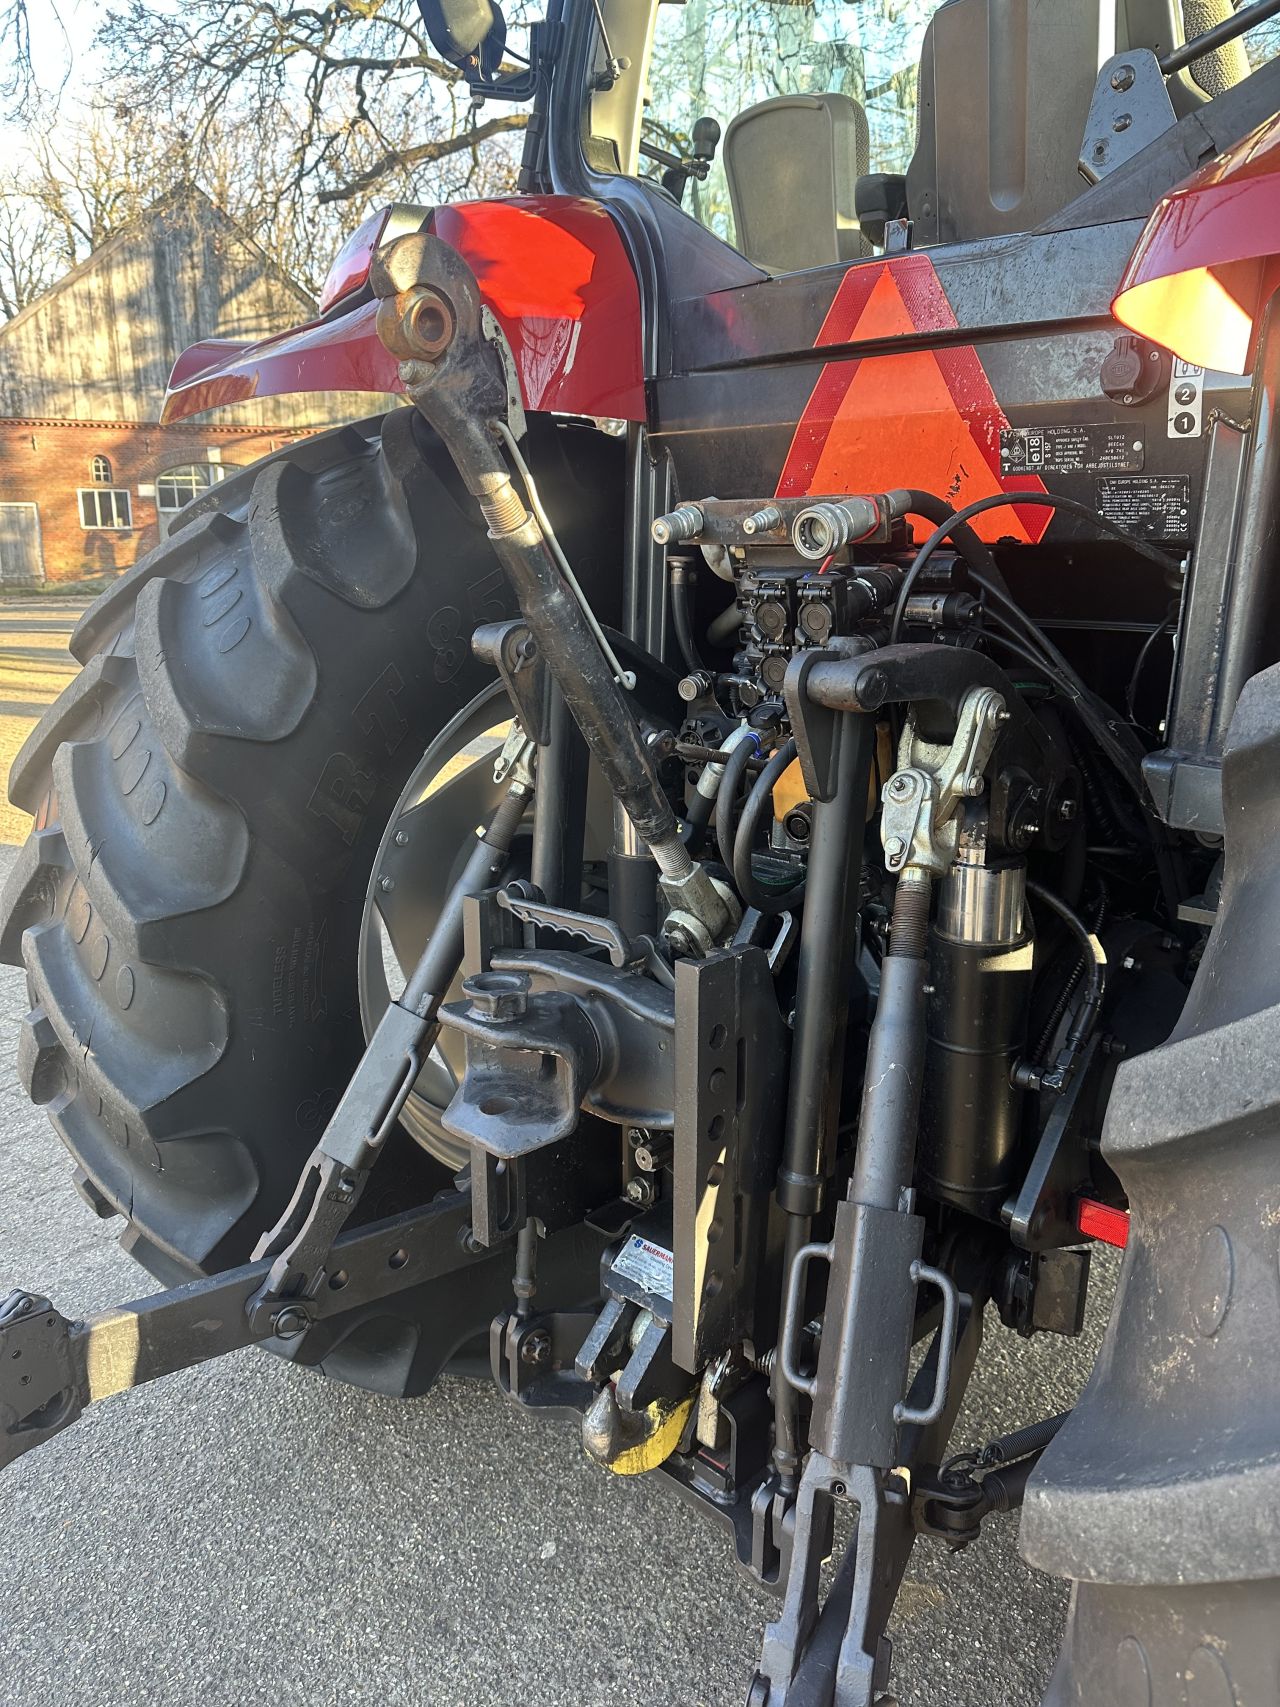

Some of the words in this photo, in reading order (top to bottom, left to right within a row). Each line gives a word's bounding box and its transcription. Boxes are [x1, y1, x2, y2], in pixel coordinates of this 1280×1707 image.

[1181, 388, 1190, 401] 2
[1181, 417, 1188, 430] 1
[1029, 438, 1041, 462] e18
[272, 945, 288, 1016] TUBELESS
[642, 1244, 673, 1263] SAUERMAN
